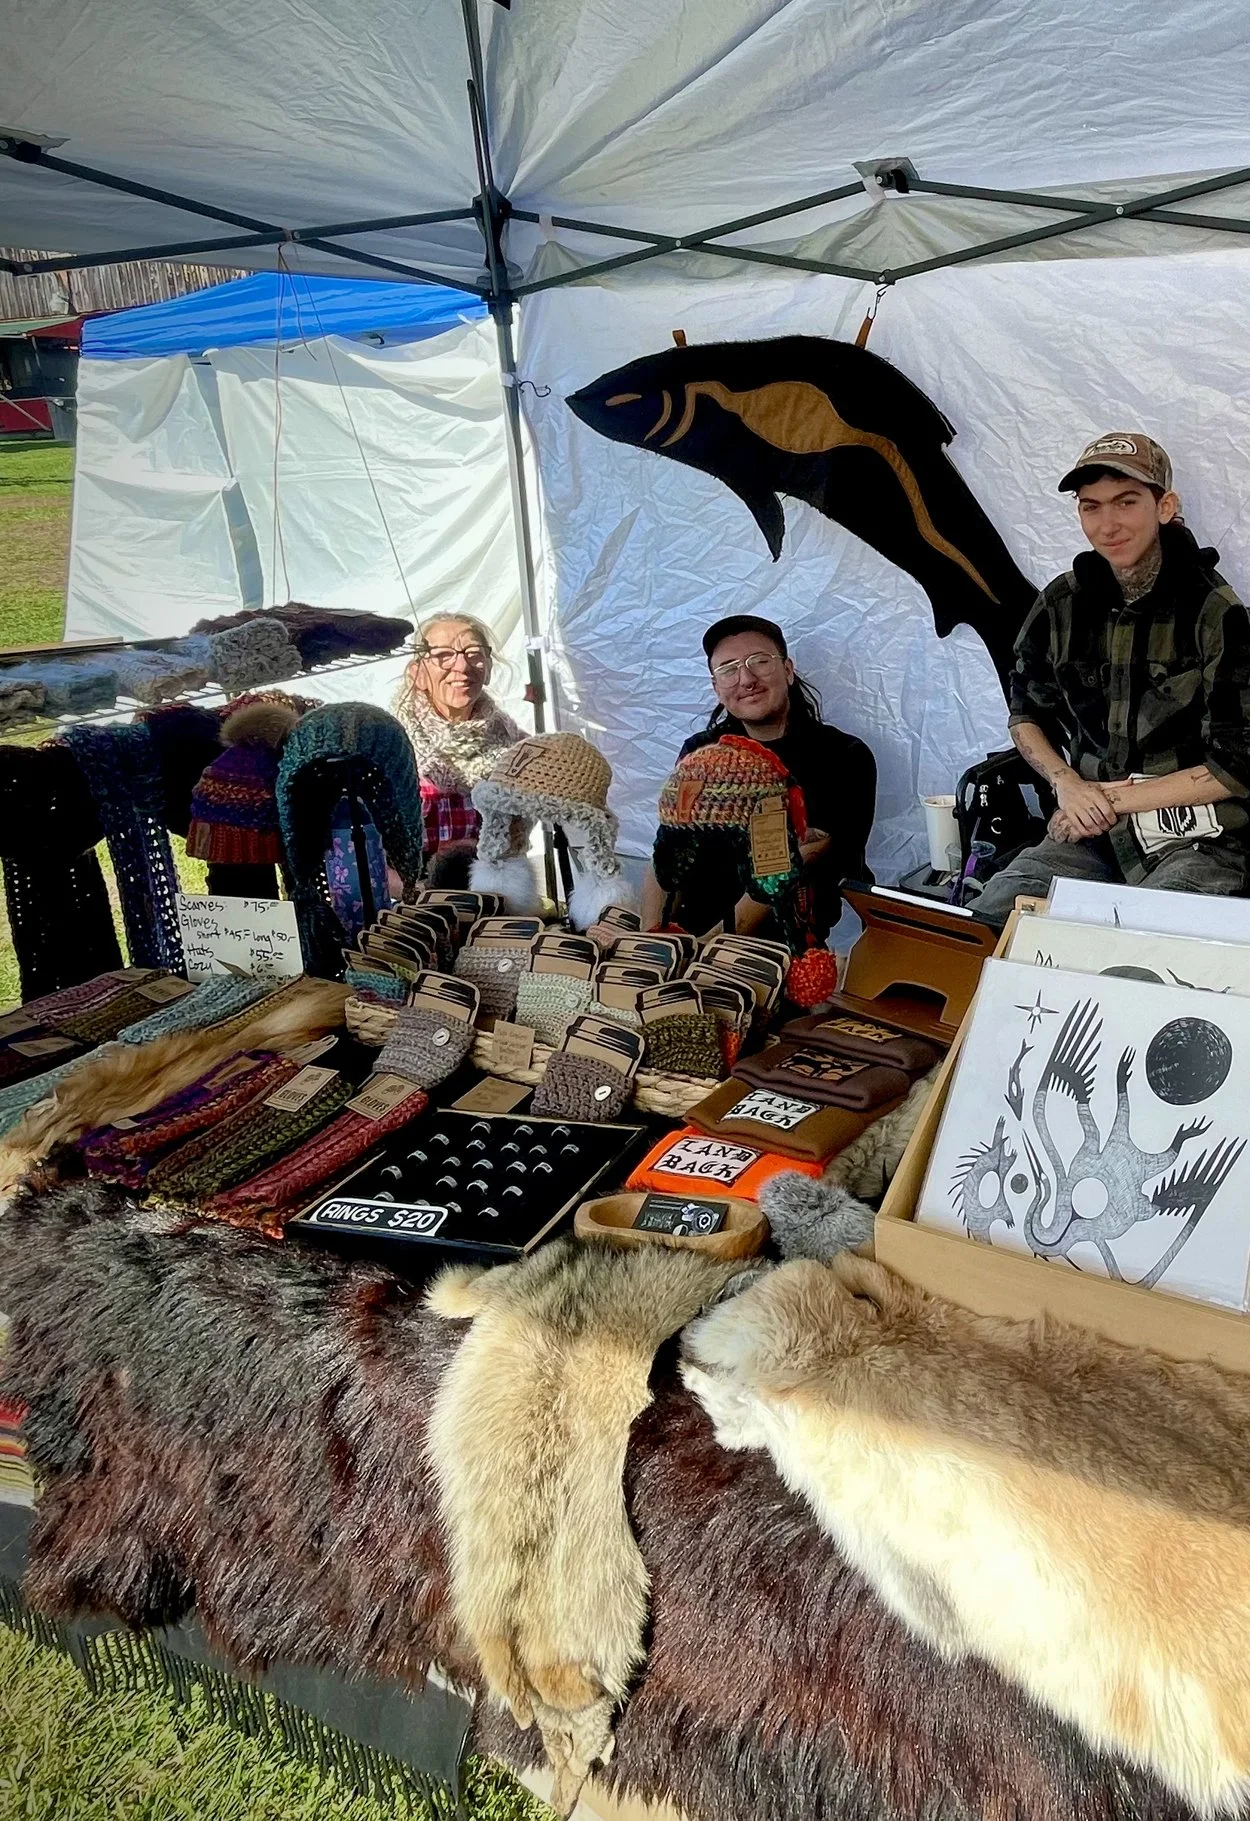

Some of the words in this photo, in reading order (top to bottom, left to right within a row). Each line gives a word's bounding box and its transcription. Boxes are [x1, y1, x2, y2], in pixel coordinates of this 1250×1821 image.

[181, 914, 219, 932] Gloves
[278, 1089, 308, 1102] GLOVES
[360, 1095, 390, 1113] GLOVES
[748, 1092, 812, 1114] LAND
[730, 1104, 797, 1127] BACK
[677, 1139, 754, 1163] LAND
[660, 1154, 741, 1179] BACK
[321, 1203, 385, 1223] RINGS
